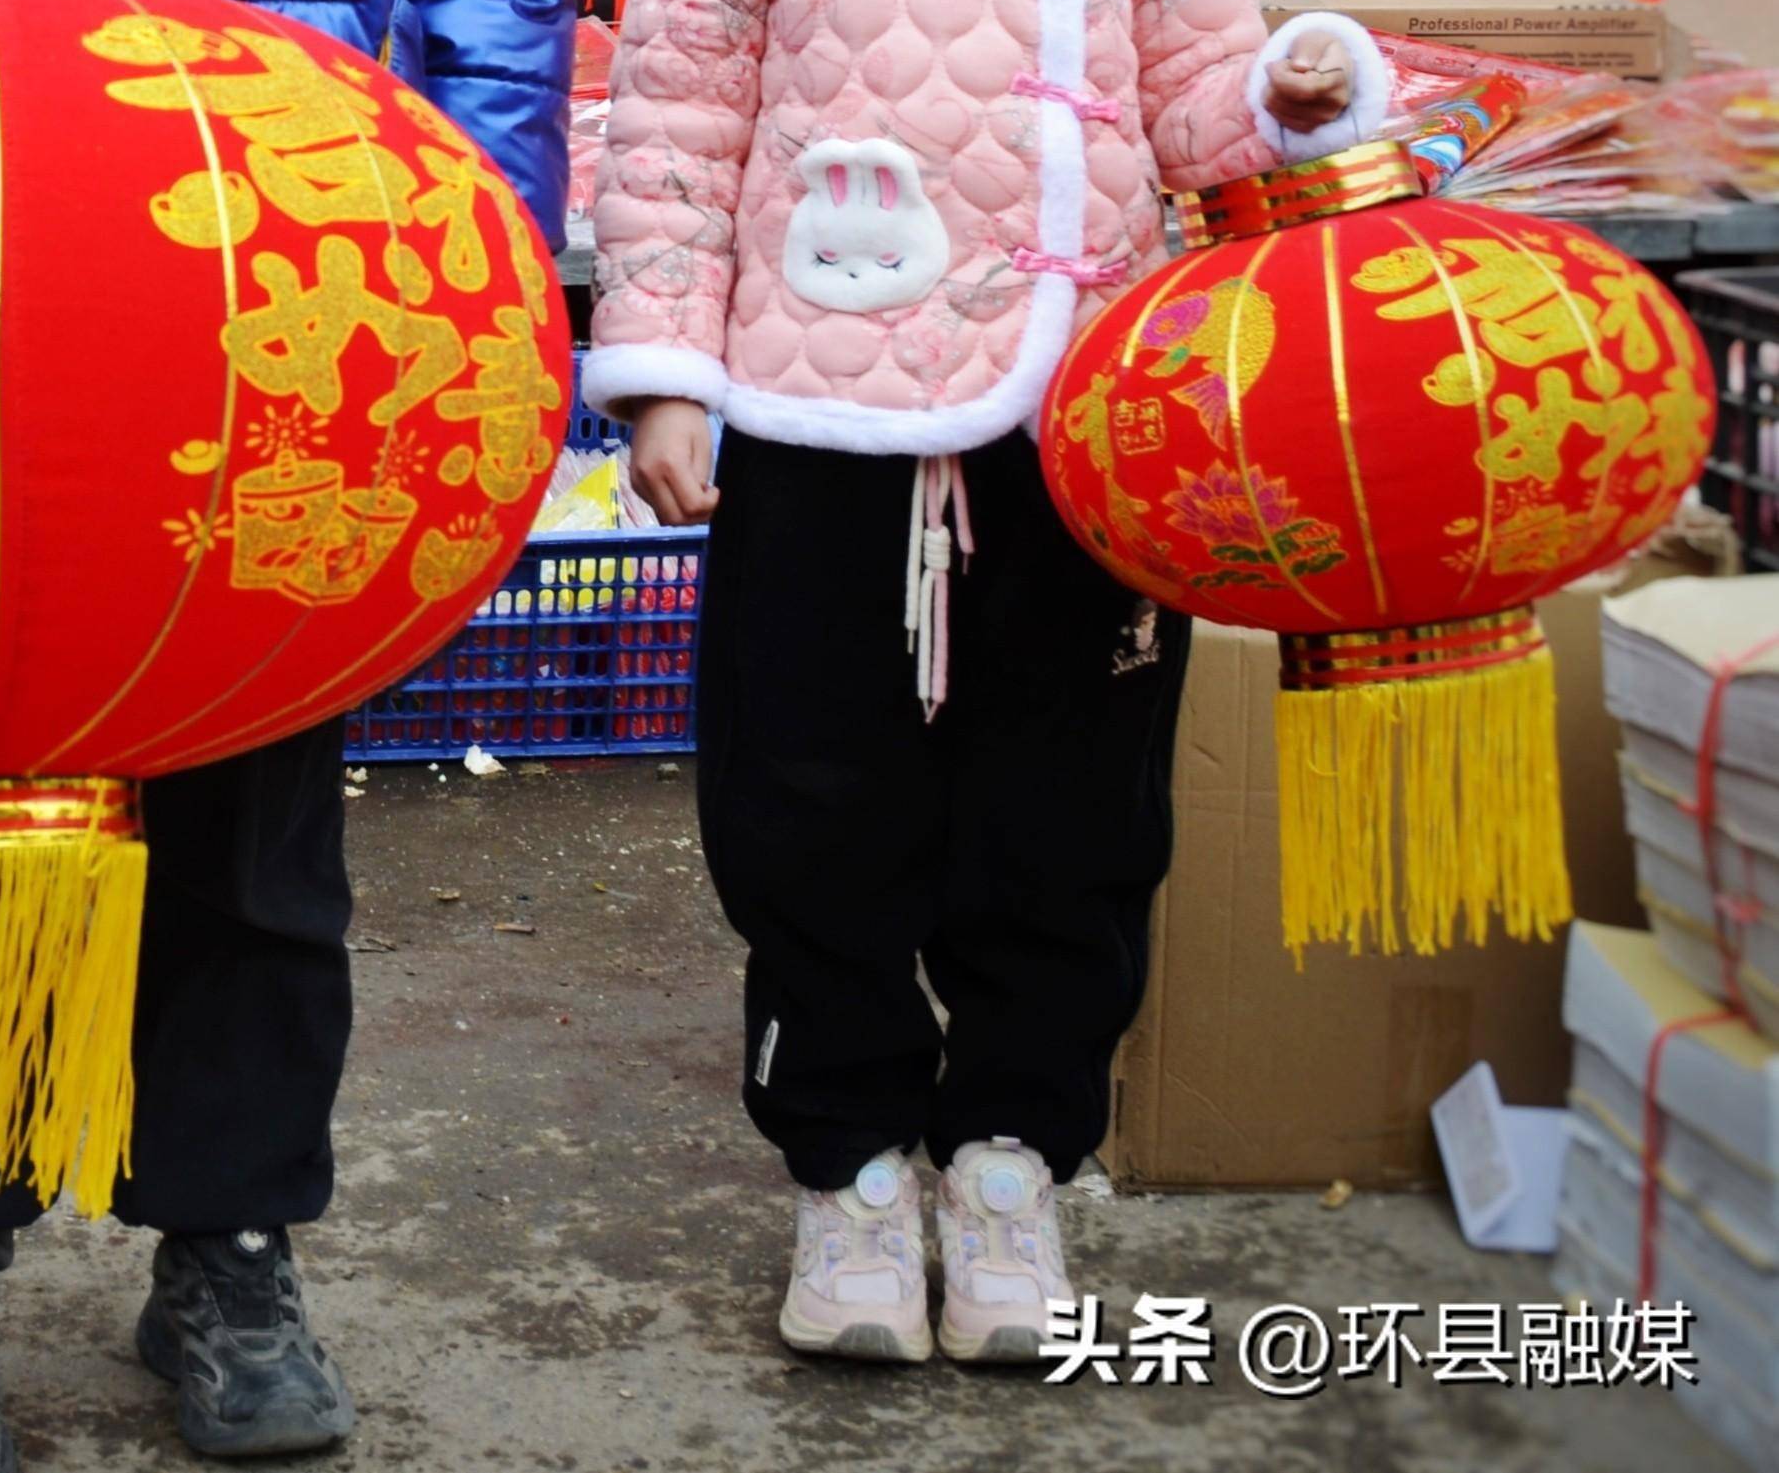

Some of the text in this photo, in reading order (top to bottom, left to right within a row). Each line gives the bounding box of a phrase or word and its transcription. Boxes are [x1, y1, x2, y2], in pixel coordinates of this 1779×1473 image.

[1408, 17, 1637, 34] Professional Power Amplifier
